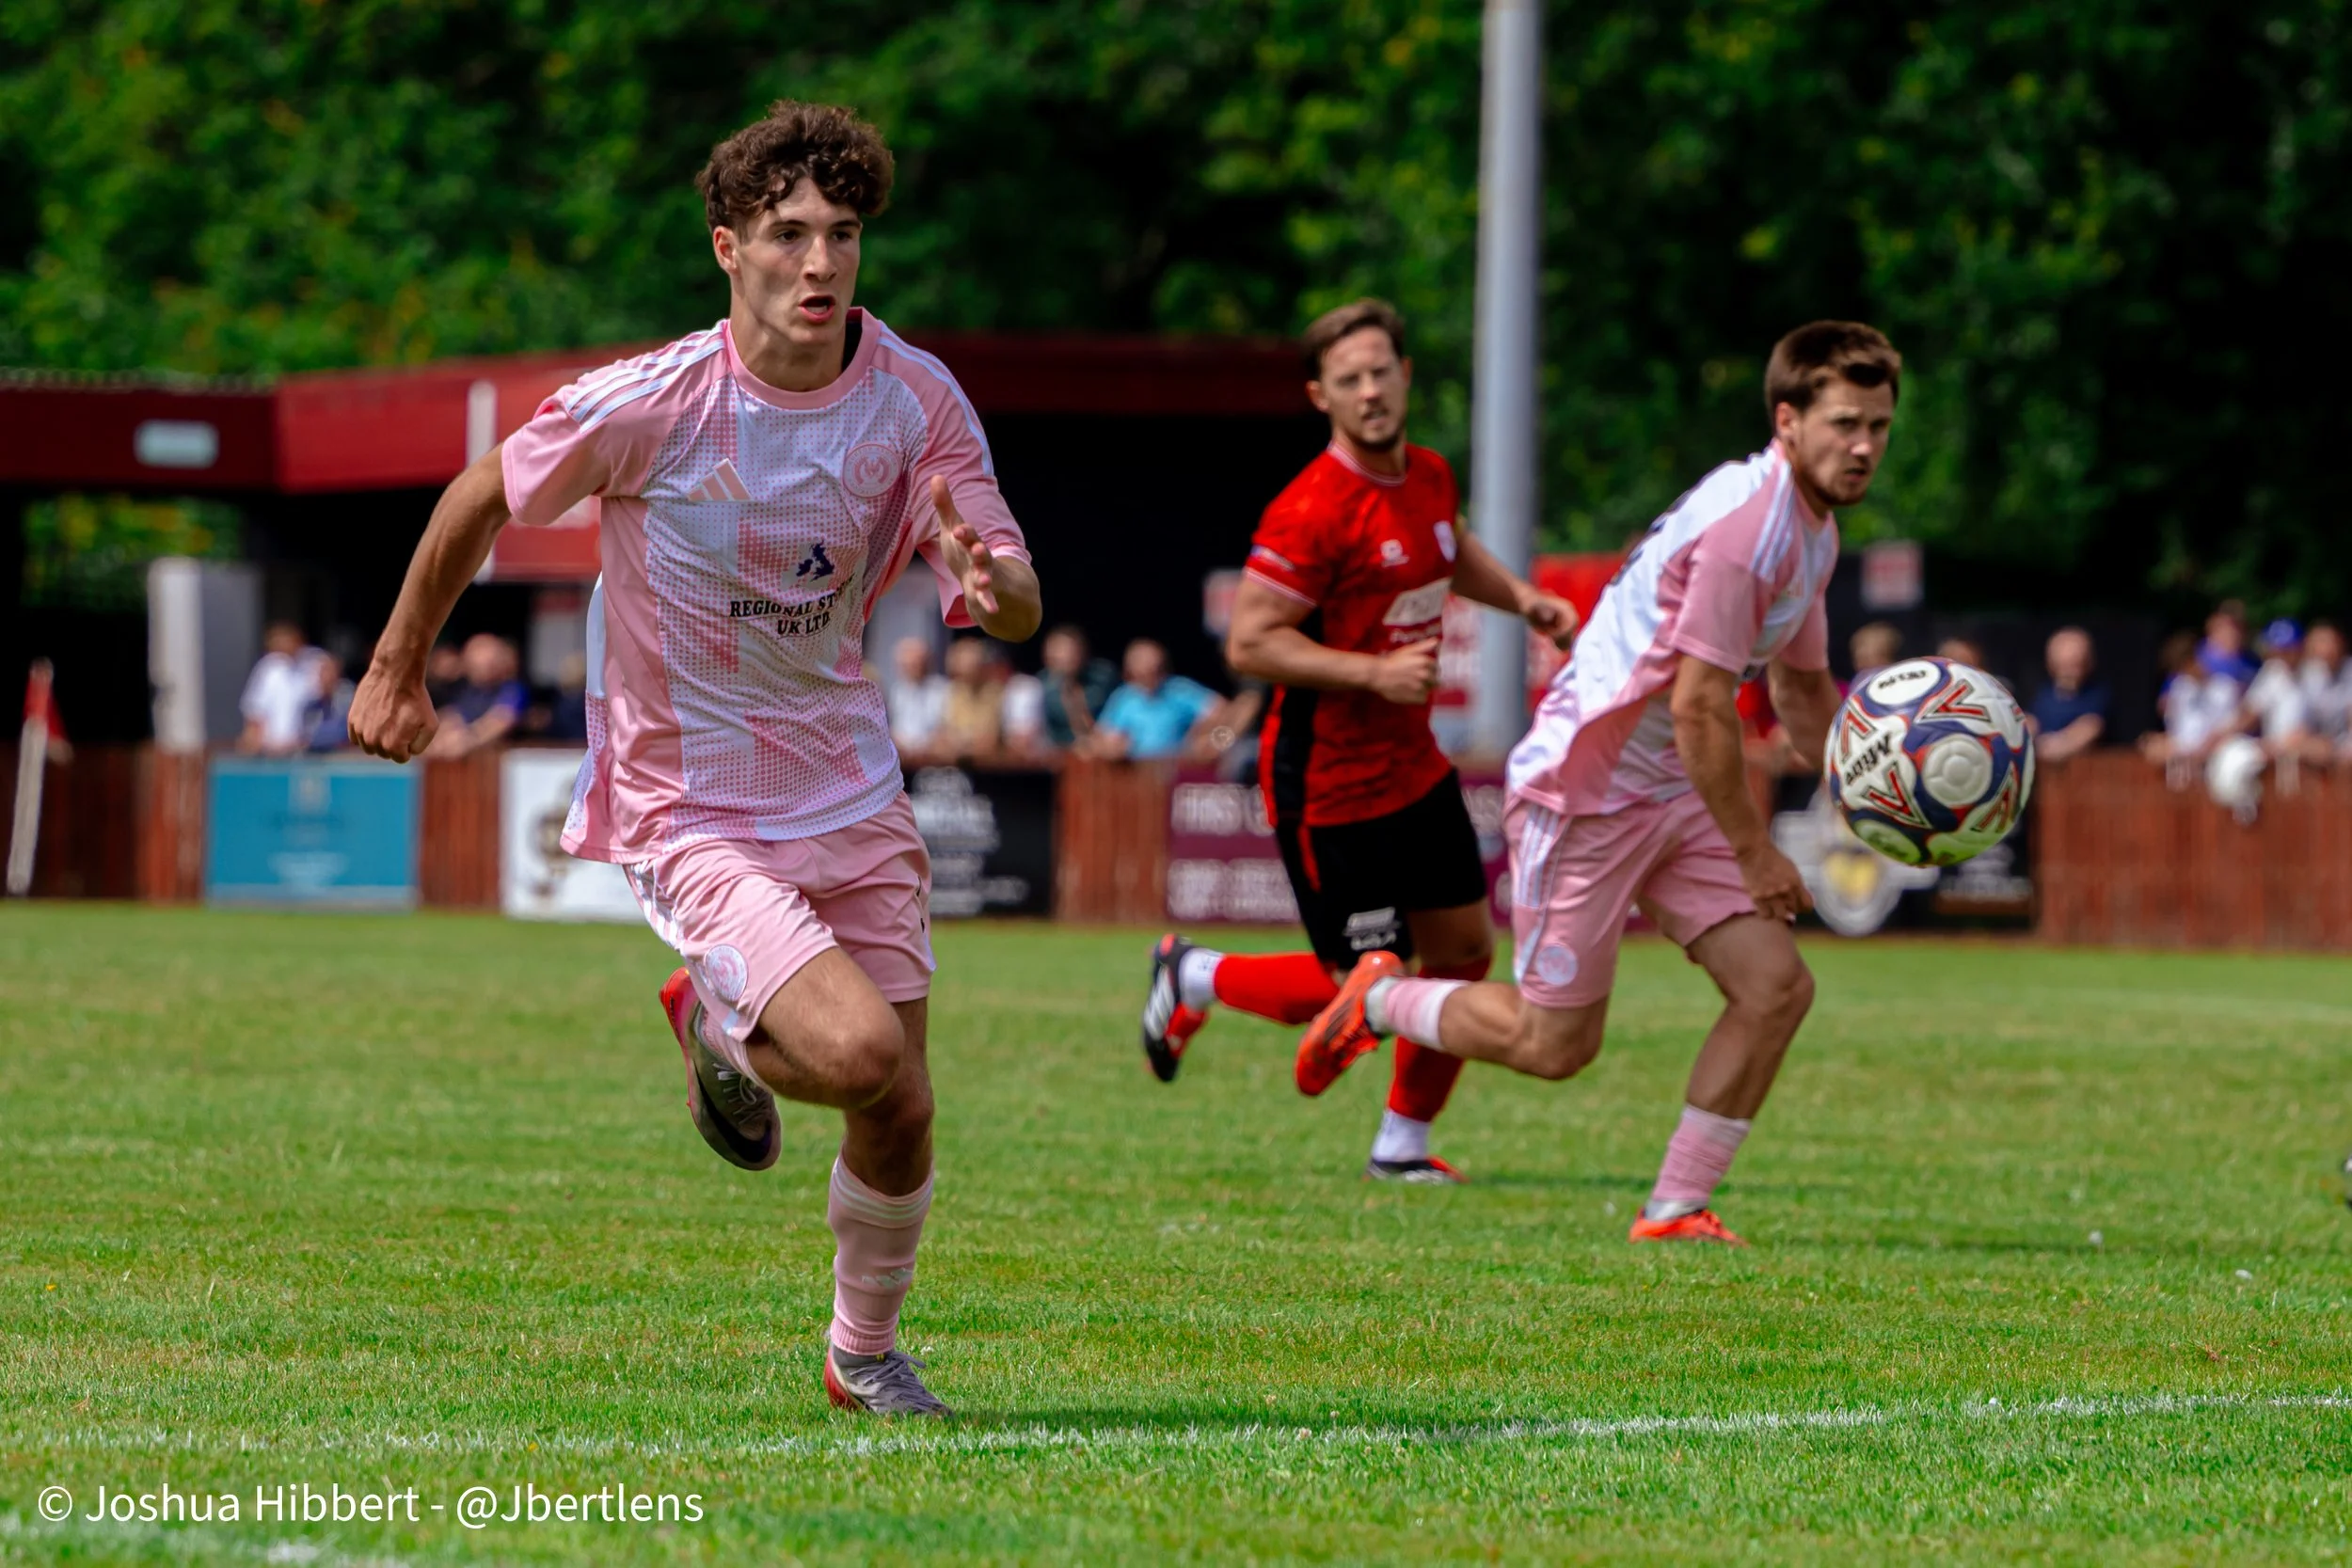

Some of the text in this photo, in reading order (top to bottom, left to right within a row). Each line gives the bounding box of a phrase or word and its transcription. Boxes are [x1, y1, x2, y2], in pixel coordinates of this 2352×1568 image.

[730, 600, 813, 618] REGIONAL
[777, 611, 830, 635] UK LTD
